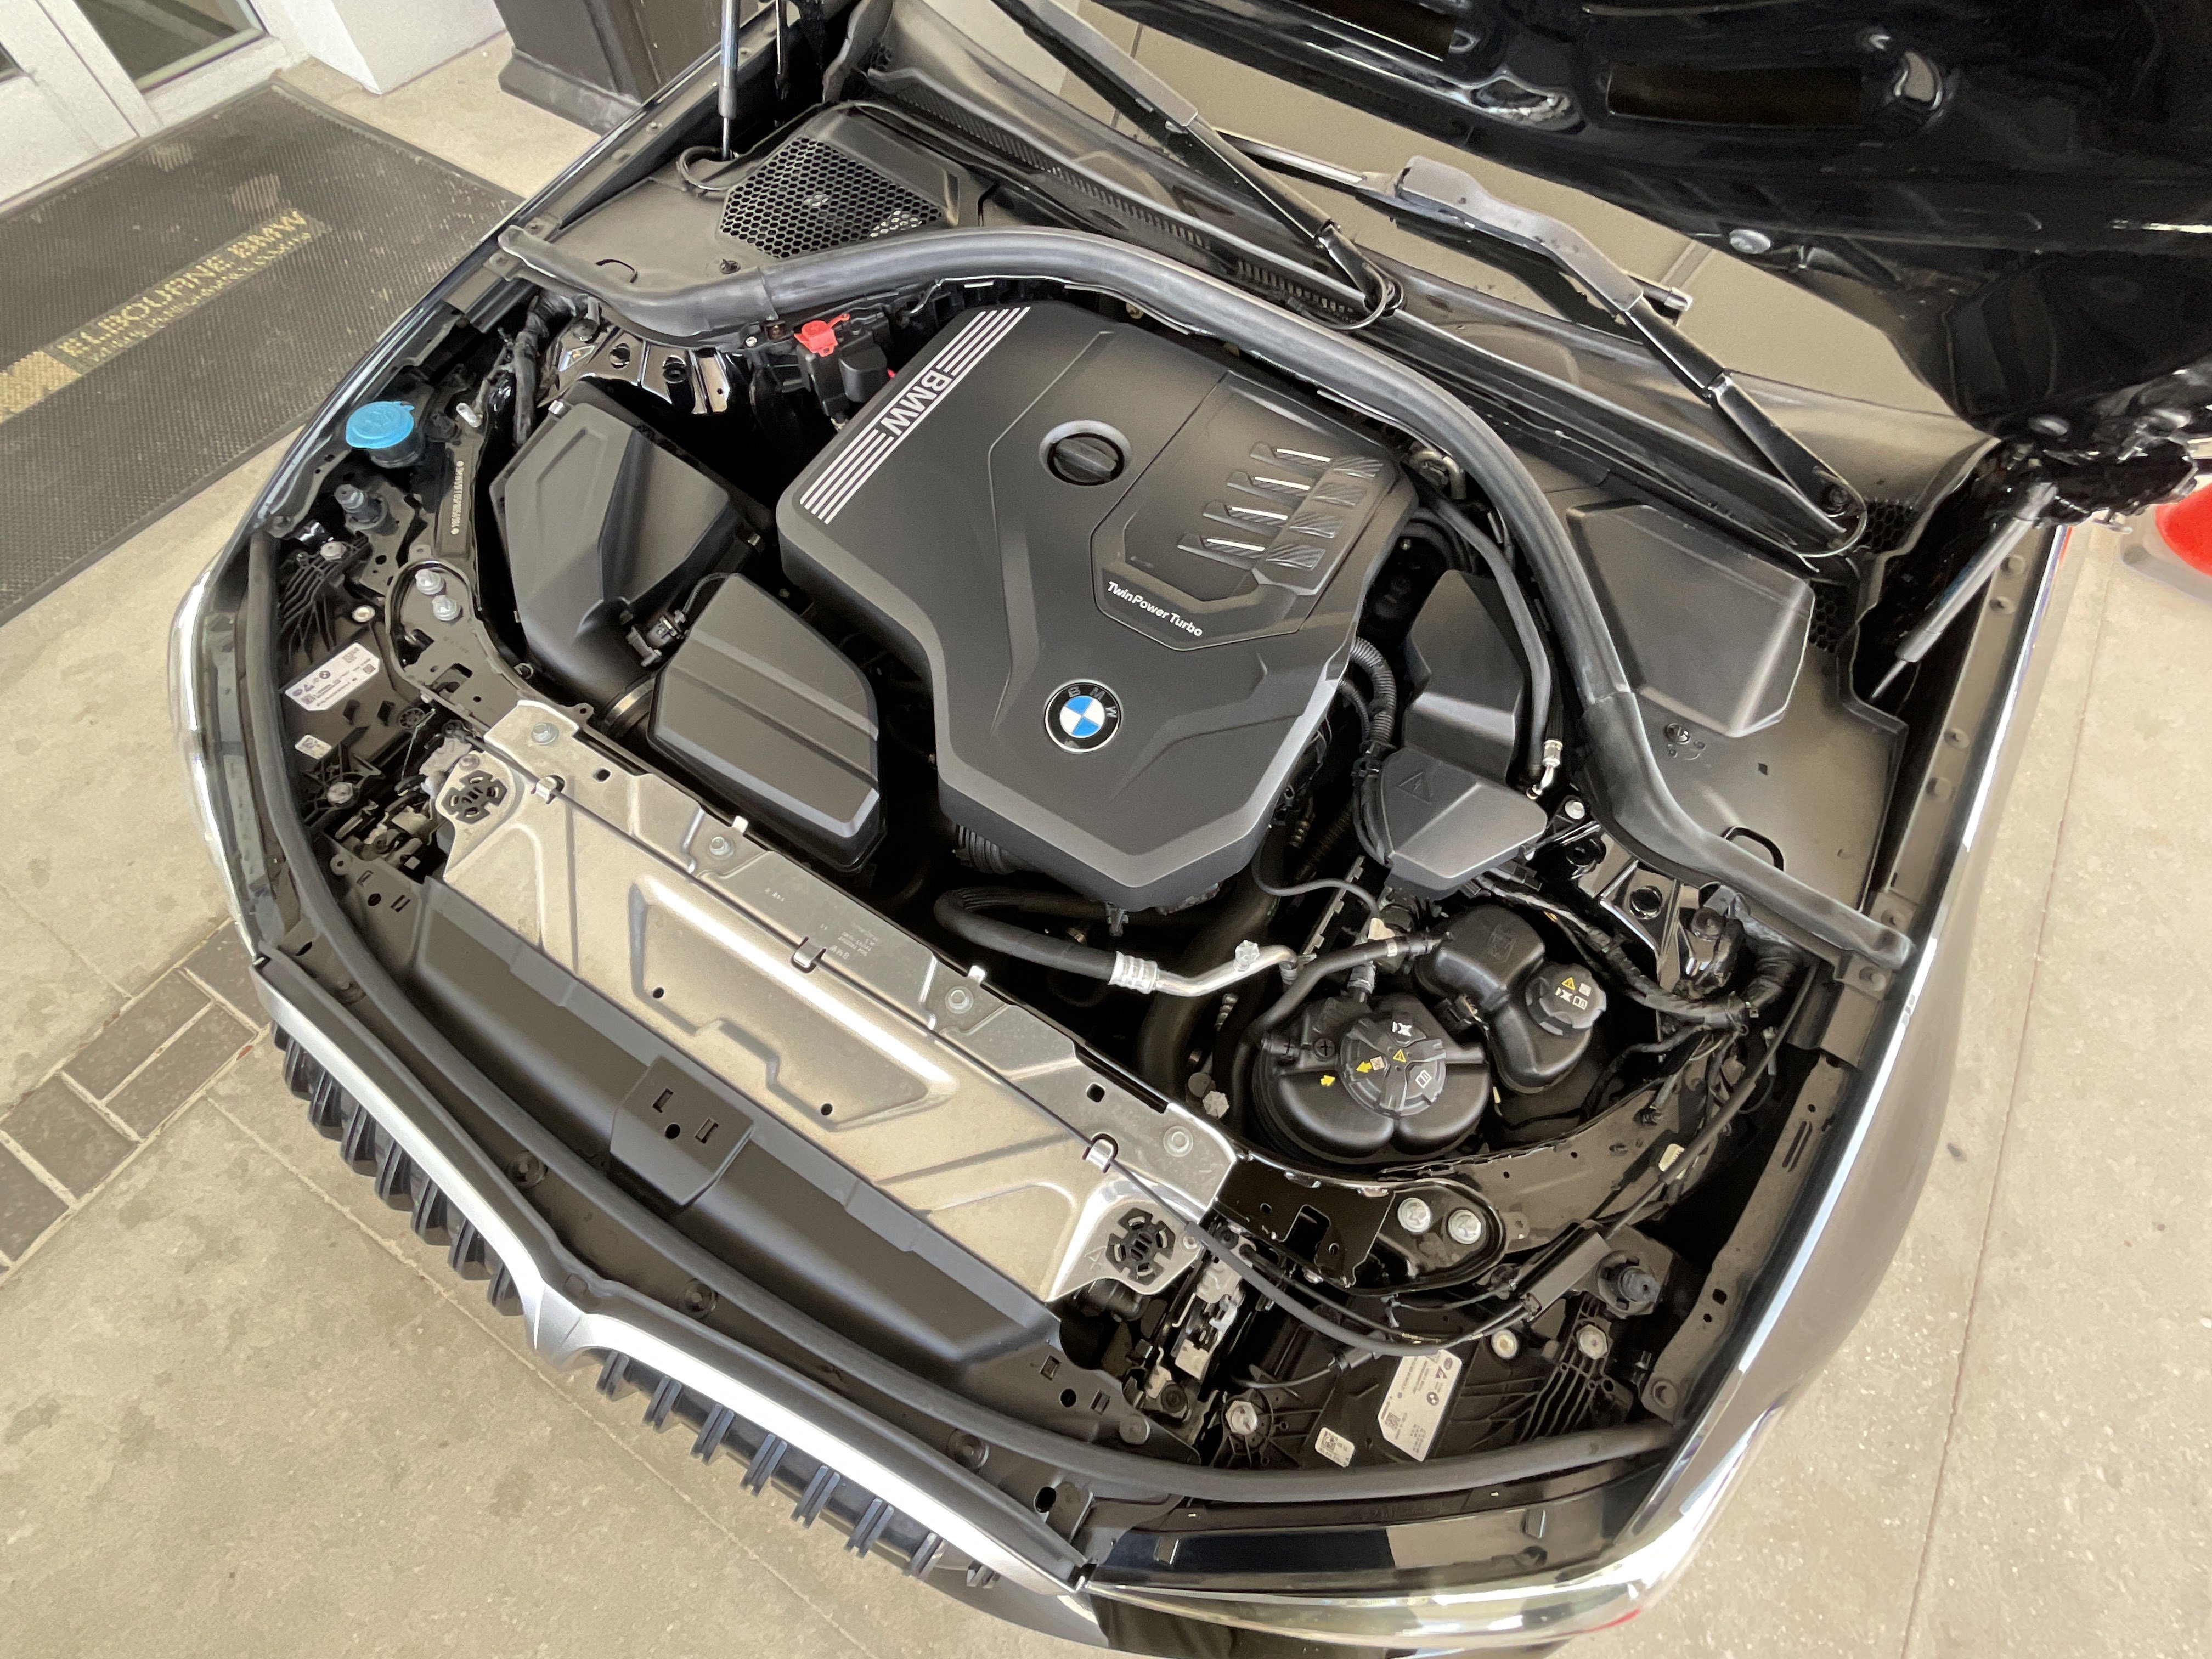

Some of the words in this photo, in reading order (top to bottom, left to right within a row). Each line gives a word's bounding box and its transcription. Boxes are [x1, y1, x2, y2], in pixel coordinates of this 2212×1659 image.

[227, 211, 307, 258] BMW
[881, 370, 952, 436] BMW
[1107, 580, 1170, 619] TwinPower
[1170, 612, 1203, 636] Turbo
[1068, 686, 1117, 718] BMW
